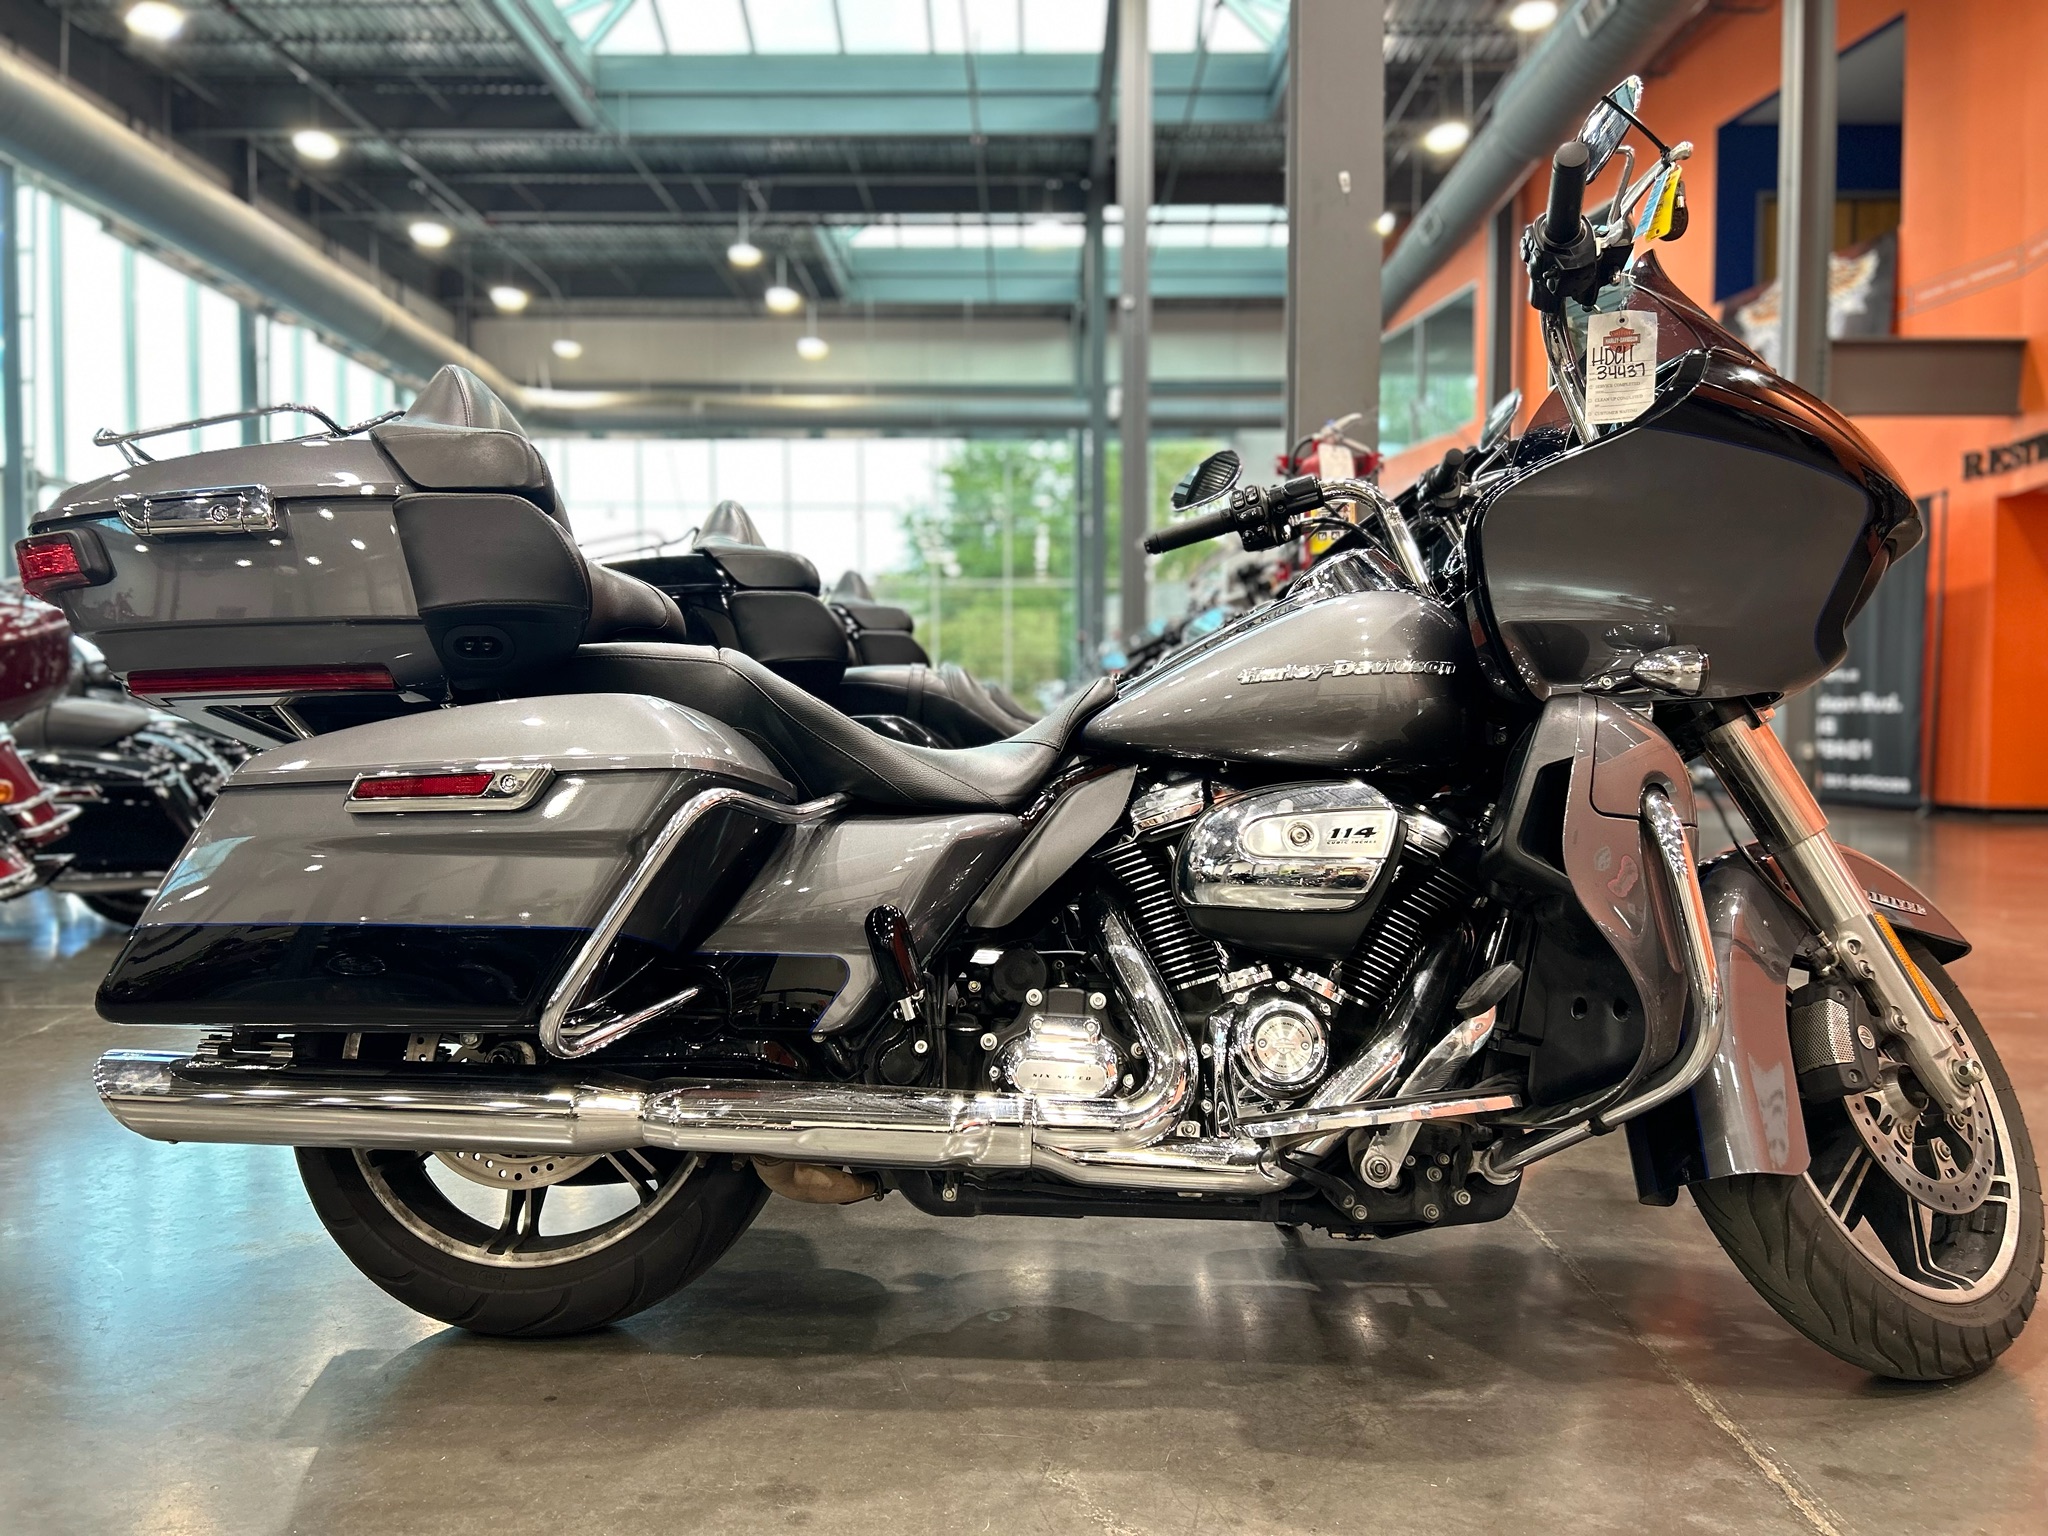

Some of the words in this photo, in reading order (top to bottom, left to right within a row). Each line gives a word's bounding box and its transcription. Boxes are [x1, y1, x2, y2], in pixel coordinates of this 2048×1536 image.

[1597, 362, 1645, 380] 34437
[1237, 658, 1456, 685] Harley-Davidson
[1330, 826, 1378, 839] 114
